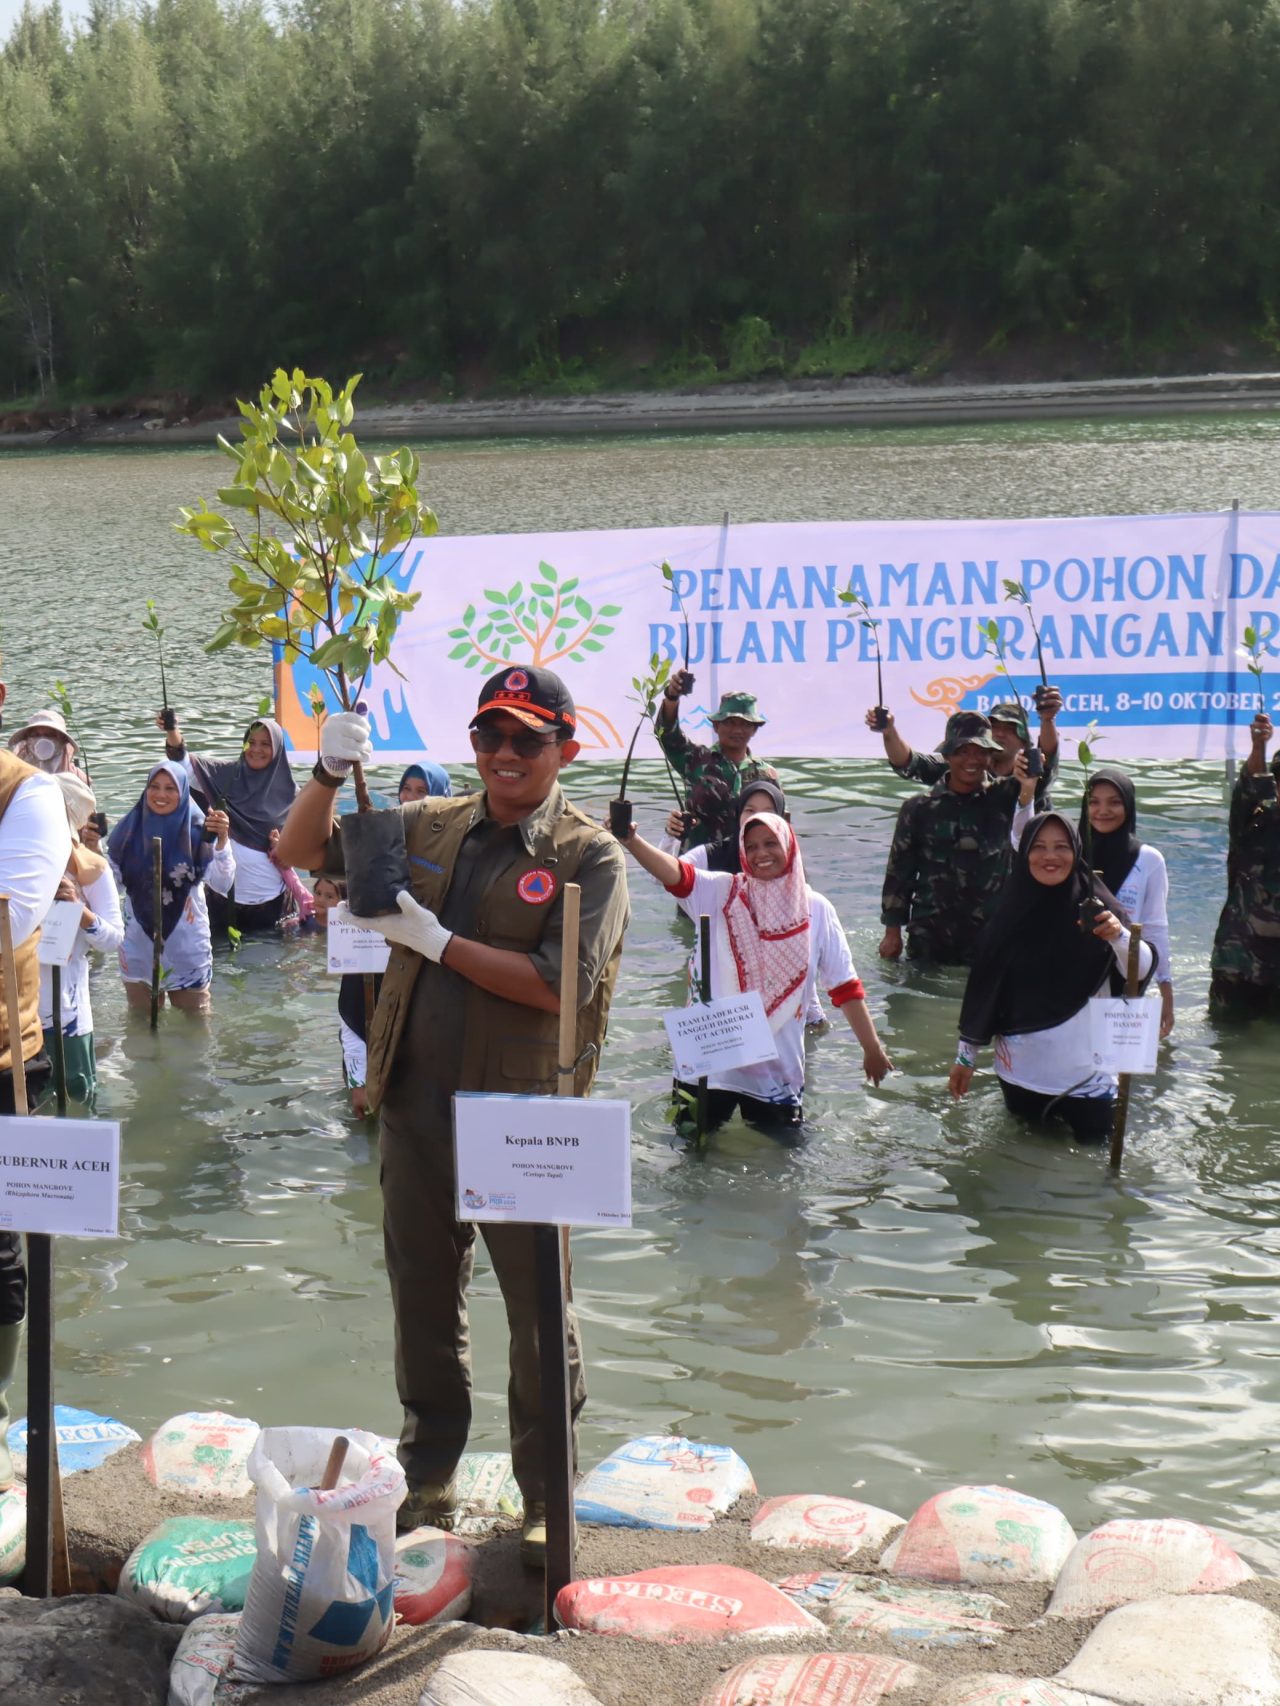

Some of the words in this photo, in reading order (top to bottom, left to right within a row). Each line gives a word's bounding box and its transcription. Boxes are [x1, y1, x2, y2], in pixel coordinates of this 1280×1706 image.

[669, 561, 999, 612] PENANAMAN
[1020, 553, 1207, 603] POHON
[648, 619, 807, 665] BULAN
[826, 611, 1226, 663] PENGURANGAN
[976, 692, 1037, 713] BAND
[1169, 691, 1266, 712] OKTOBER
[505, 1136, 543, 1149] Kepala
[546, 1136, 580, 1148] BNPB
[71, 1160, 111, 1173] ACEH
[593, 1582, 737, 1615] SPECIAL
